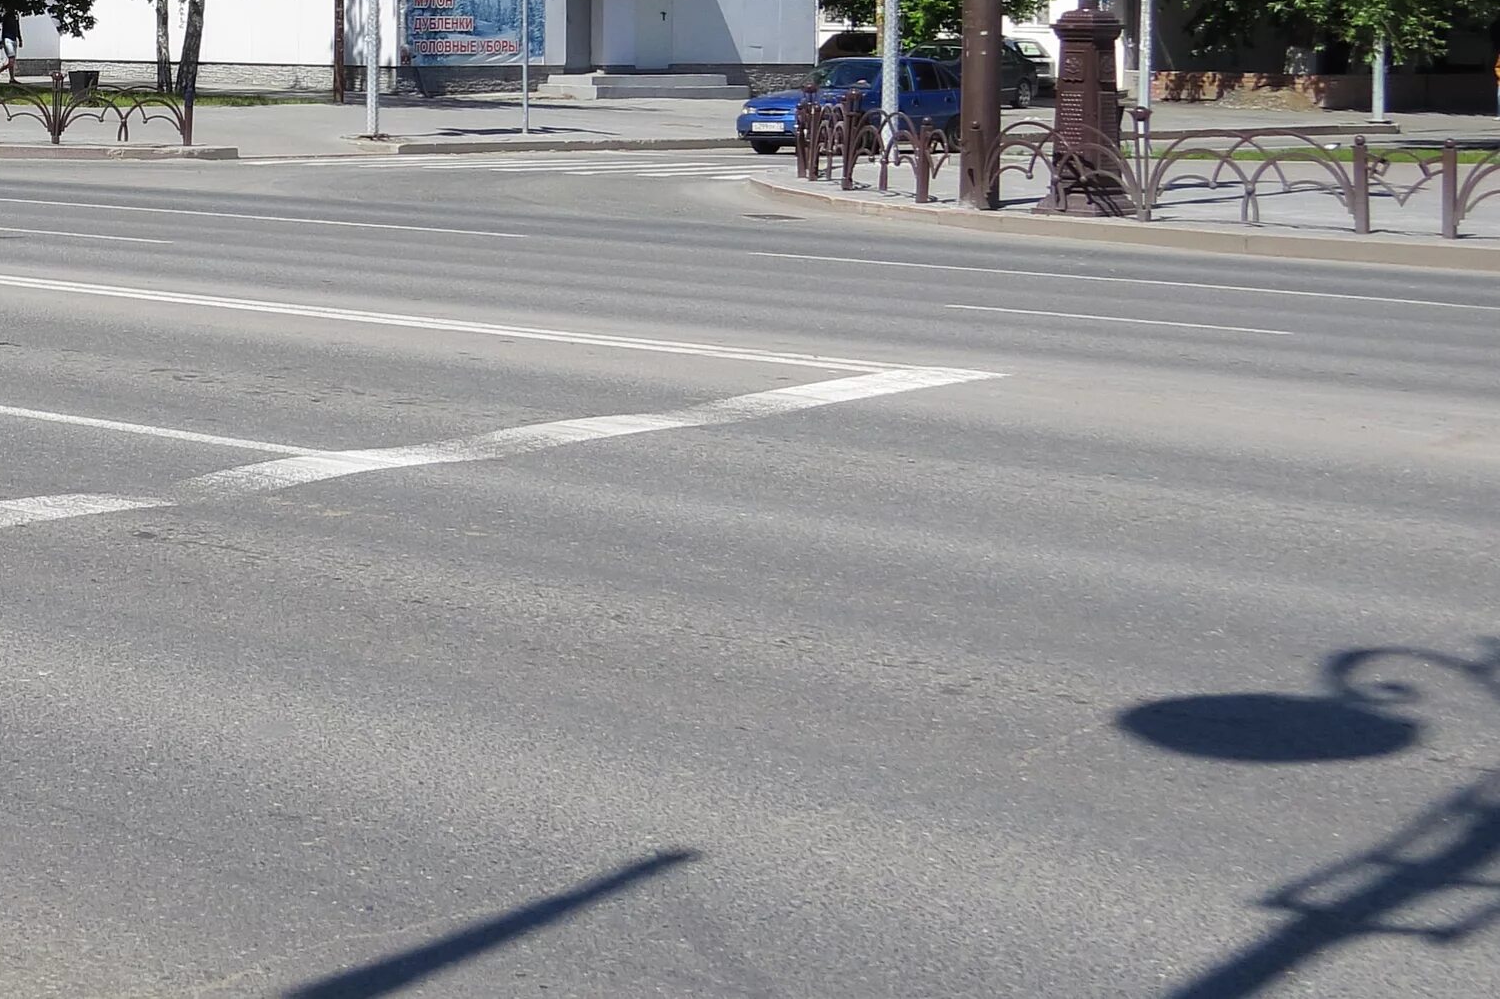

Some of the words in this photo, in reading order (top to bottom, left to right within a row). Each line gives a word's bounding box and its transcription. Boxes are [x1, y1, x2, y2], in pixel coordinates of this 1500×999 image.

[413, 16, 475, 32] ДУБЛЕНКИ
[414, 40, 477, 55] ГОЛОВНЫЕ
[479, 40, 520, 55] УБОРЫ
